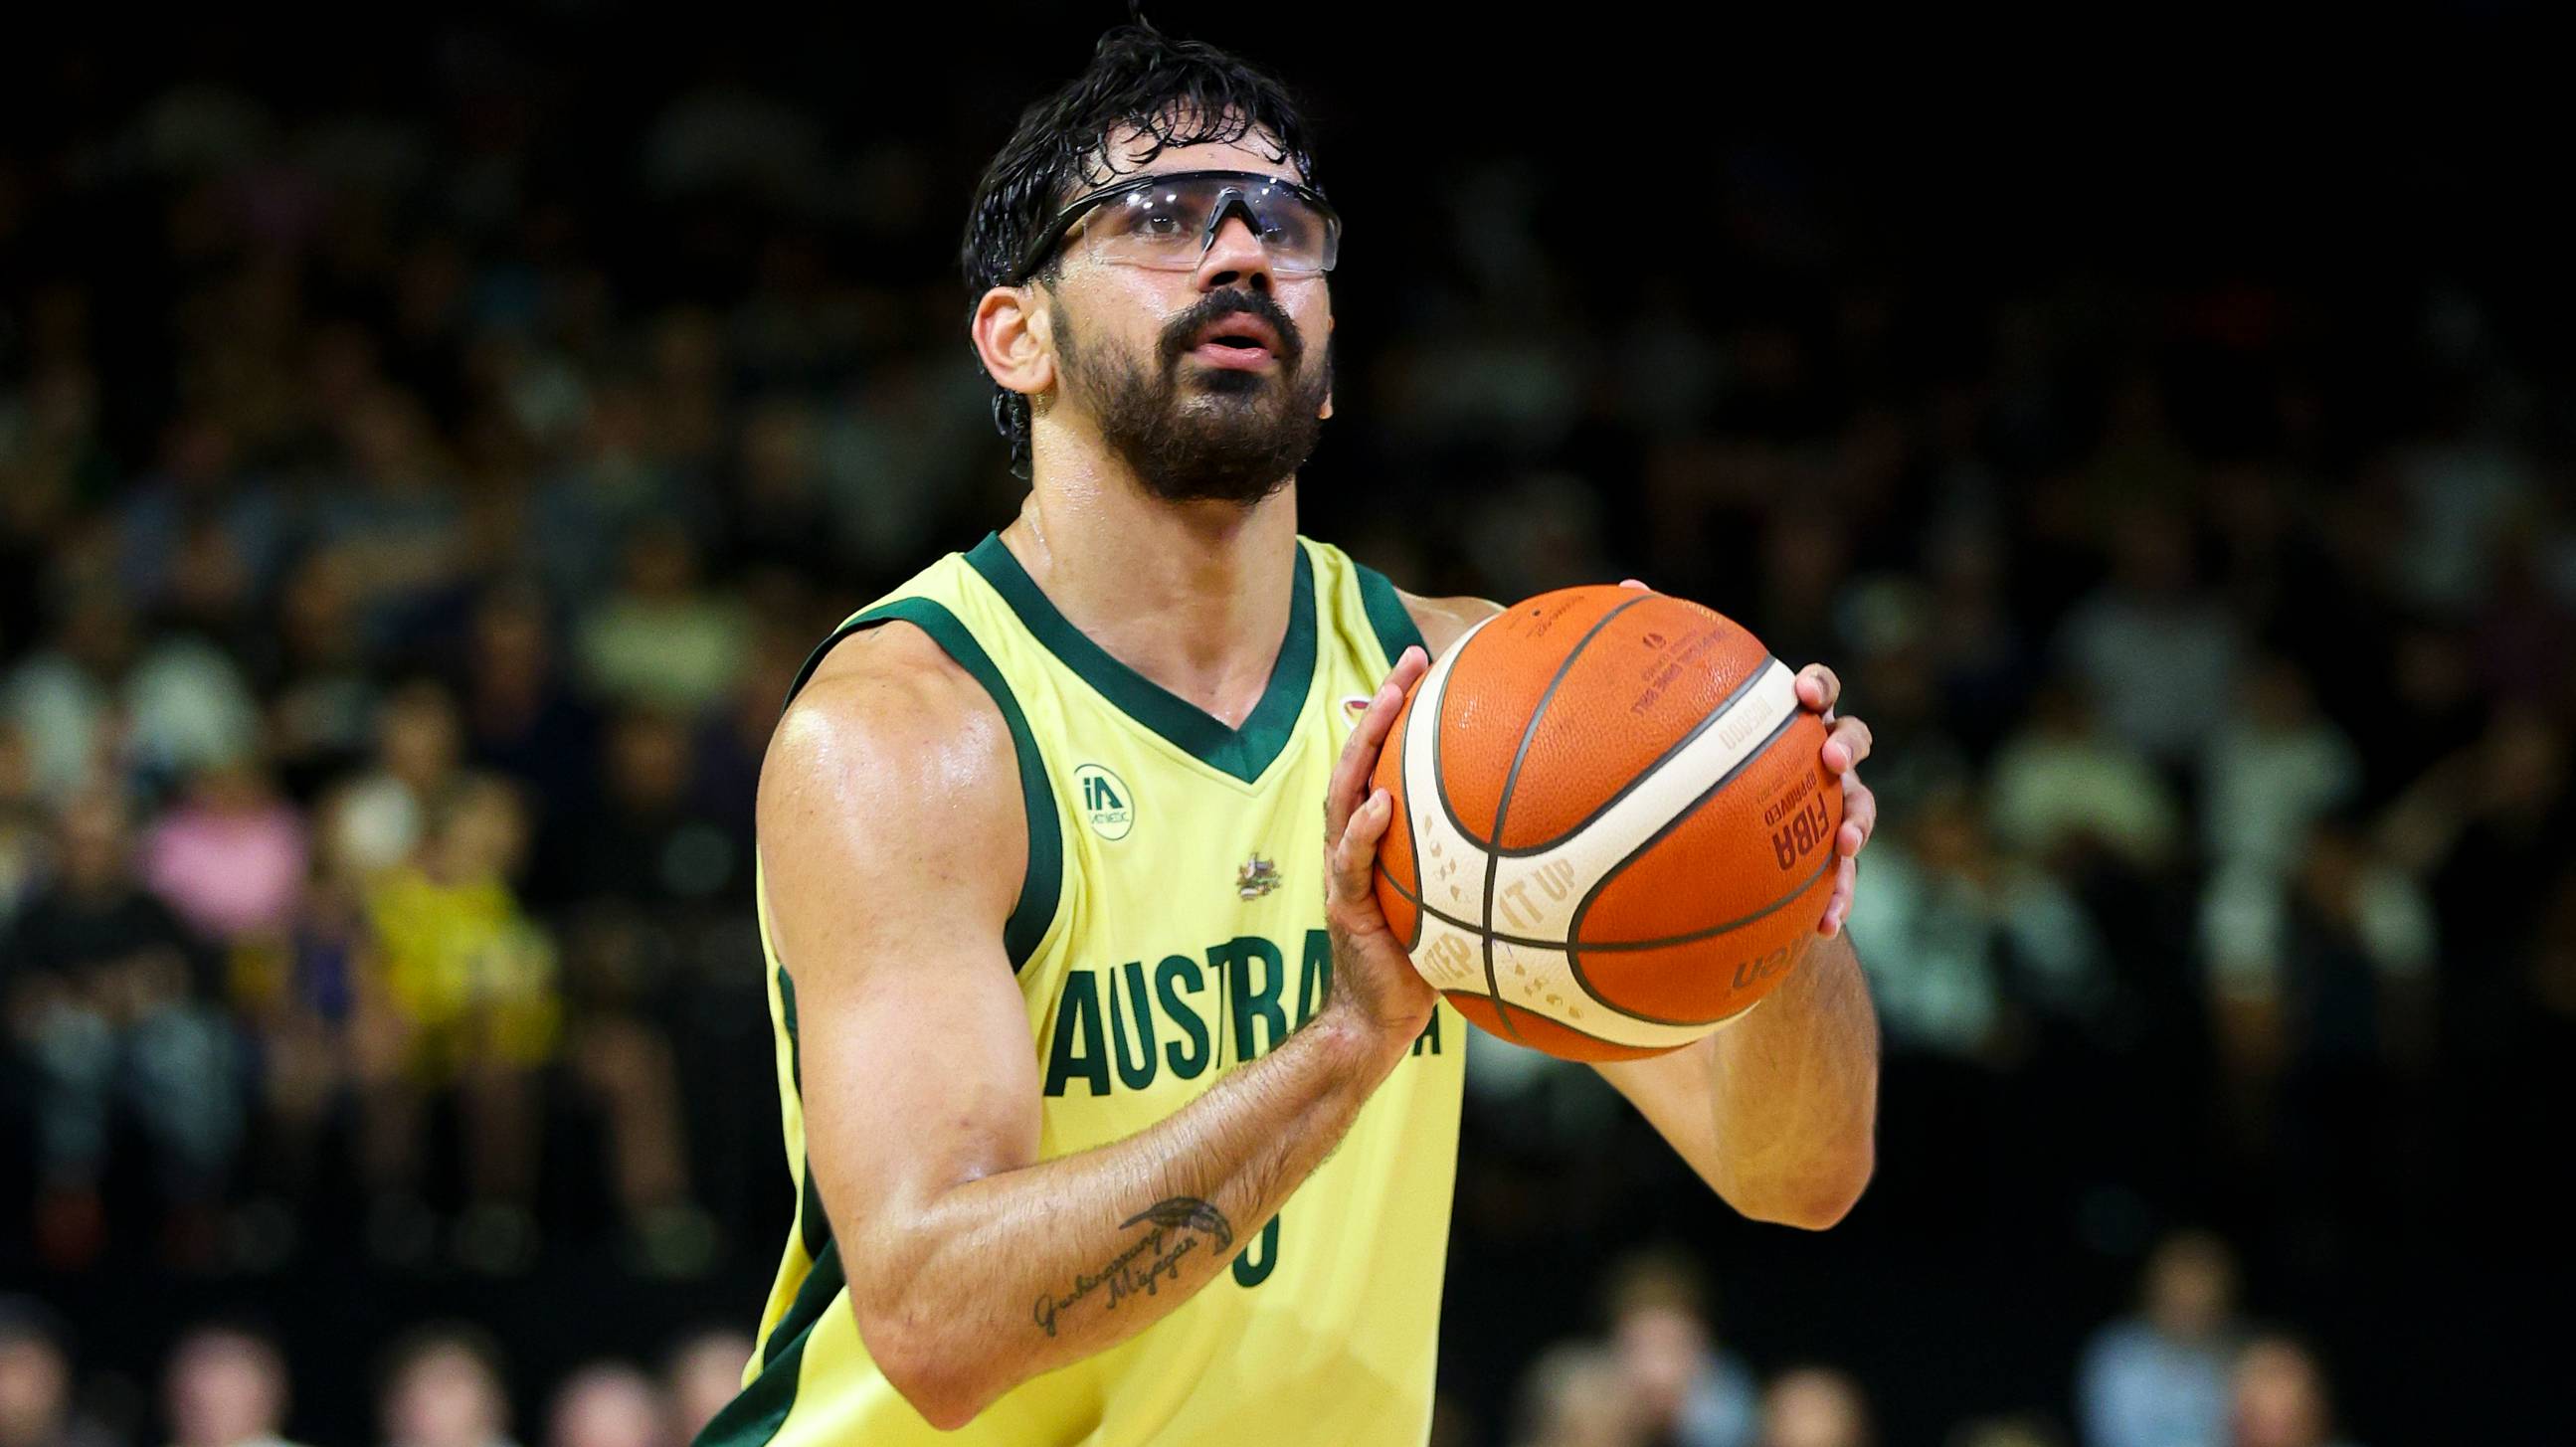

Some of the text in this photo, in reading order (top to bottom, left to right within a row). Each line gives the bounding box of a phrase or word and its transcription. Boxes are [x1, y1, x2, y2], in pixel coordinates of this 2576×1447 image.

[1764, 770, 1817, 826] APPROVED
[1771, 792, 1830, 871] FIBA
[1531, 858, 1575, 902] UP
[1043, 929, 1441, 1097] AUSTRAA
